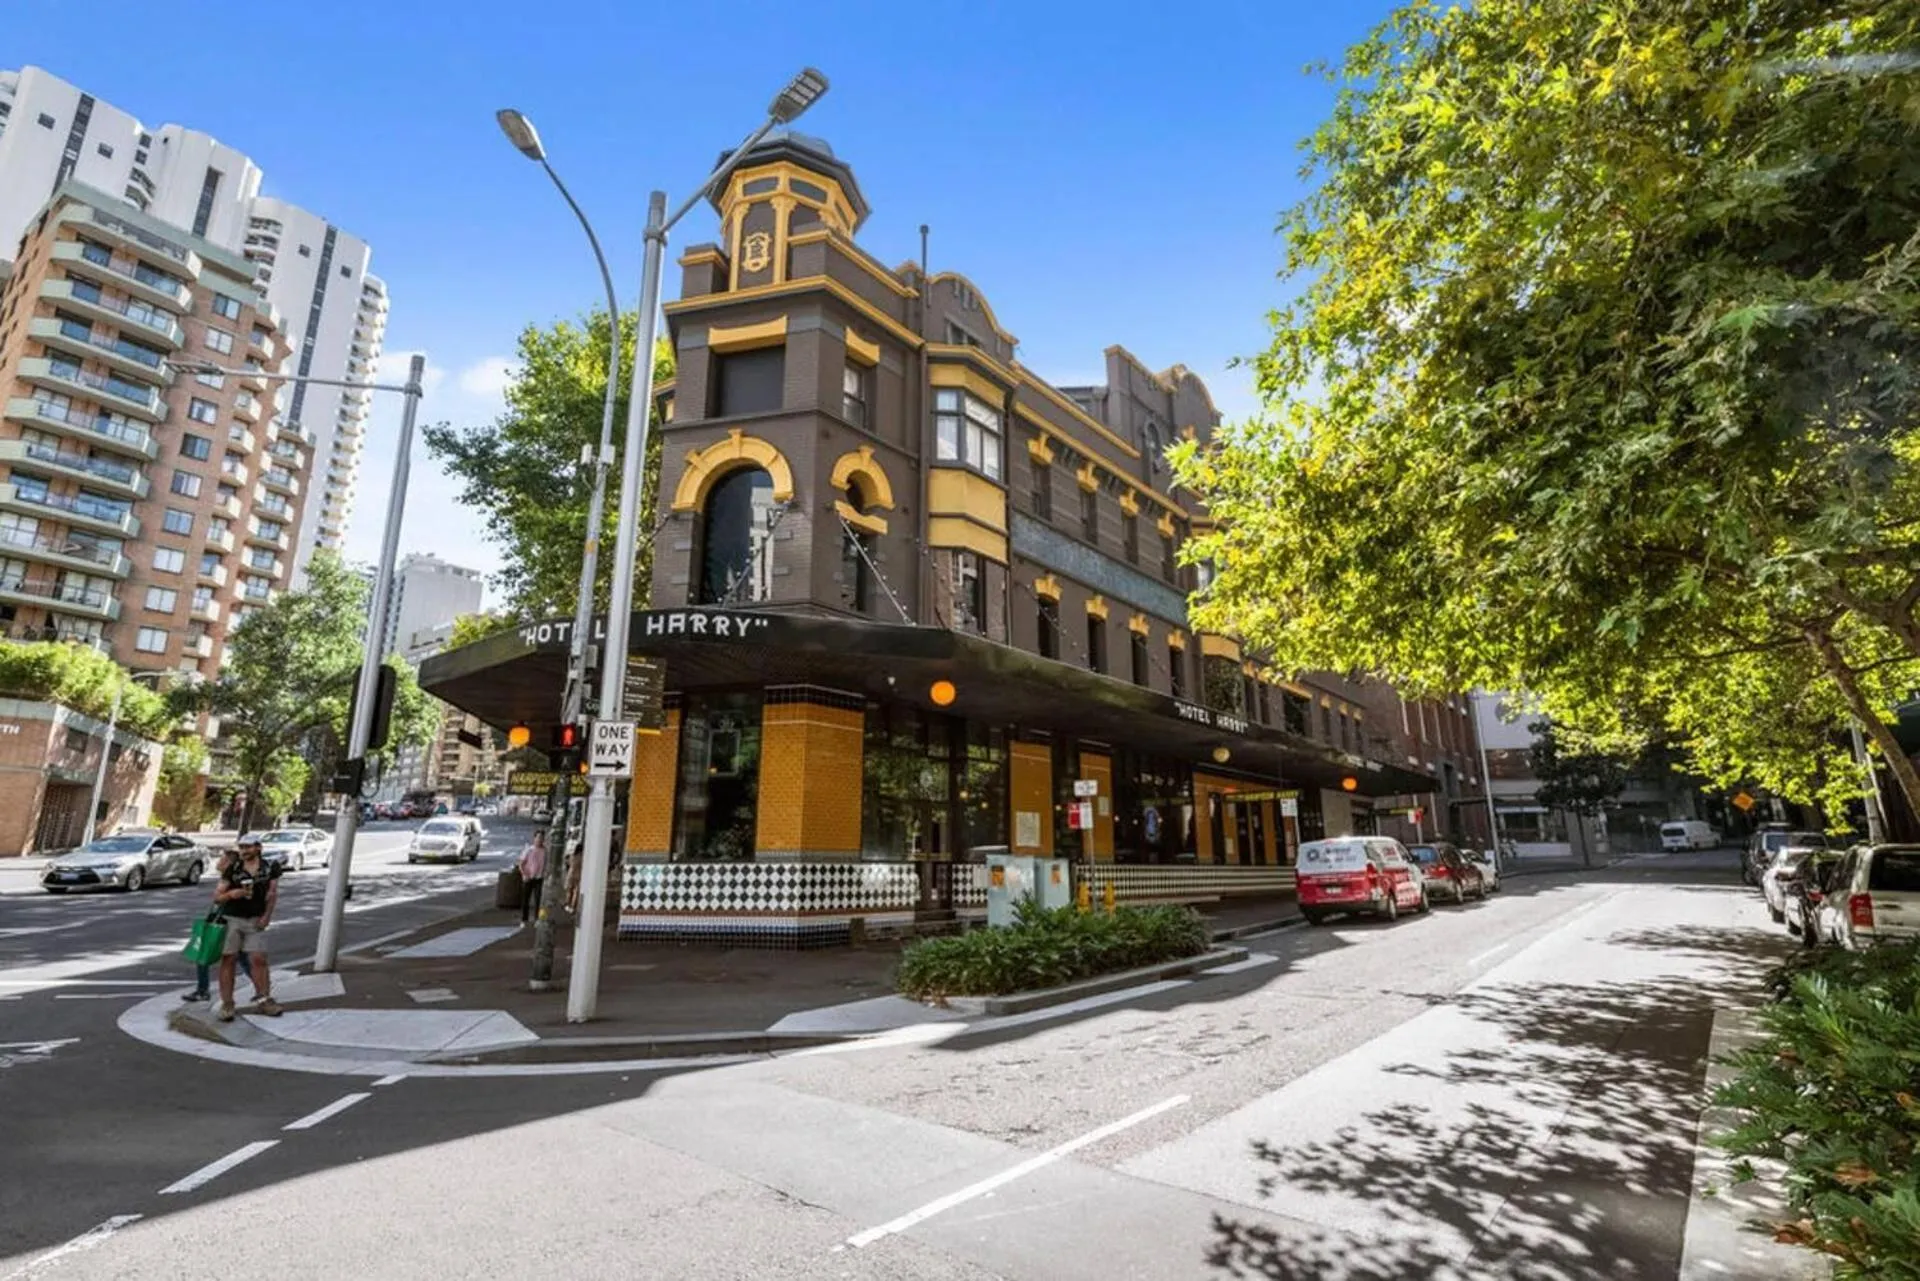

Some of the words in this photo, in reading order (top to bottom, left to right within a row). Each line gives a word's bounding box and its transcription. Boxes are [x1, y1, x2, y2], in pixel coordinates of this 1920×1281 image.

[519, 620, 605, 646] "HOTL
[599, 724, 630, 740] ONE
[595, 743, 630, 757] WAY
